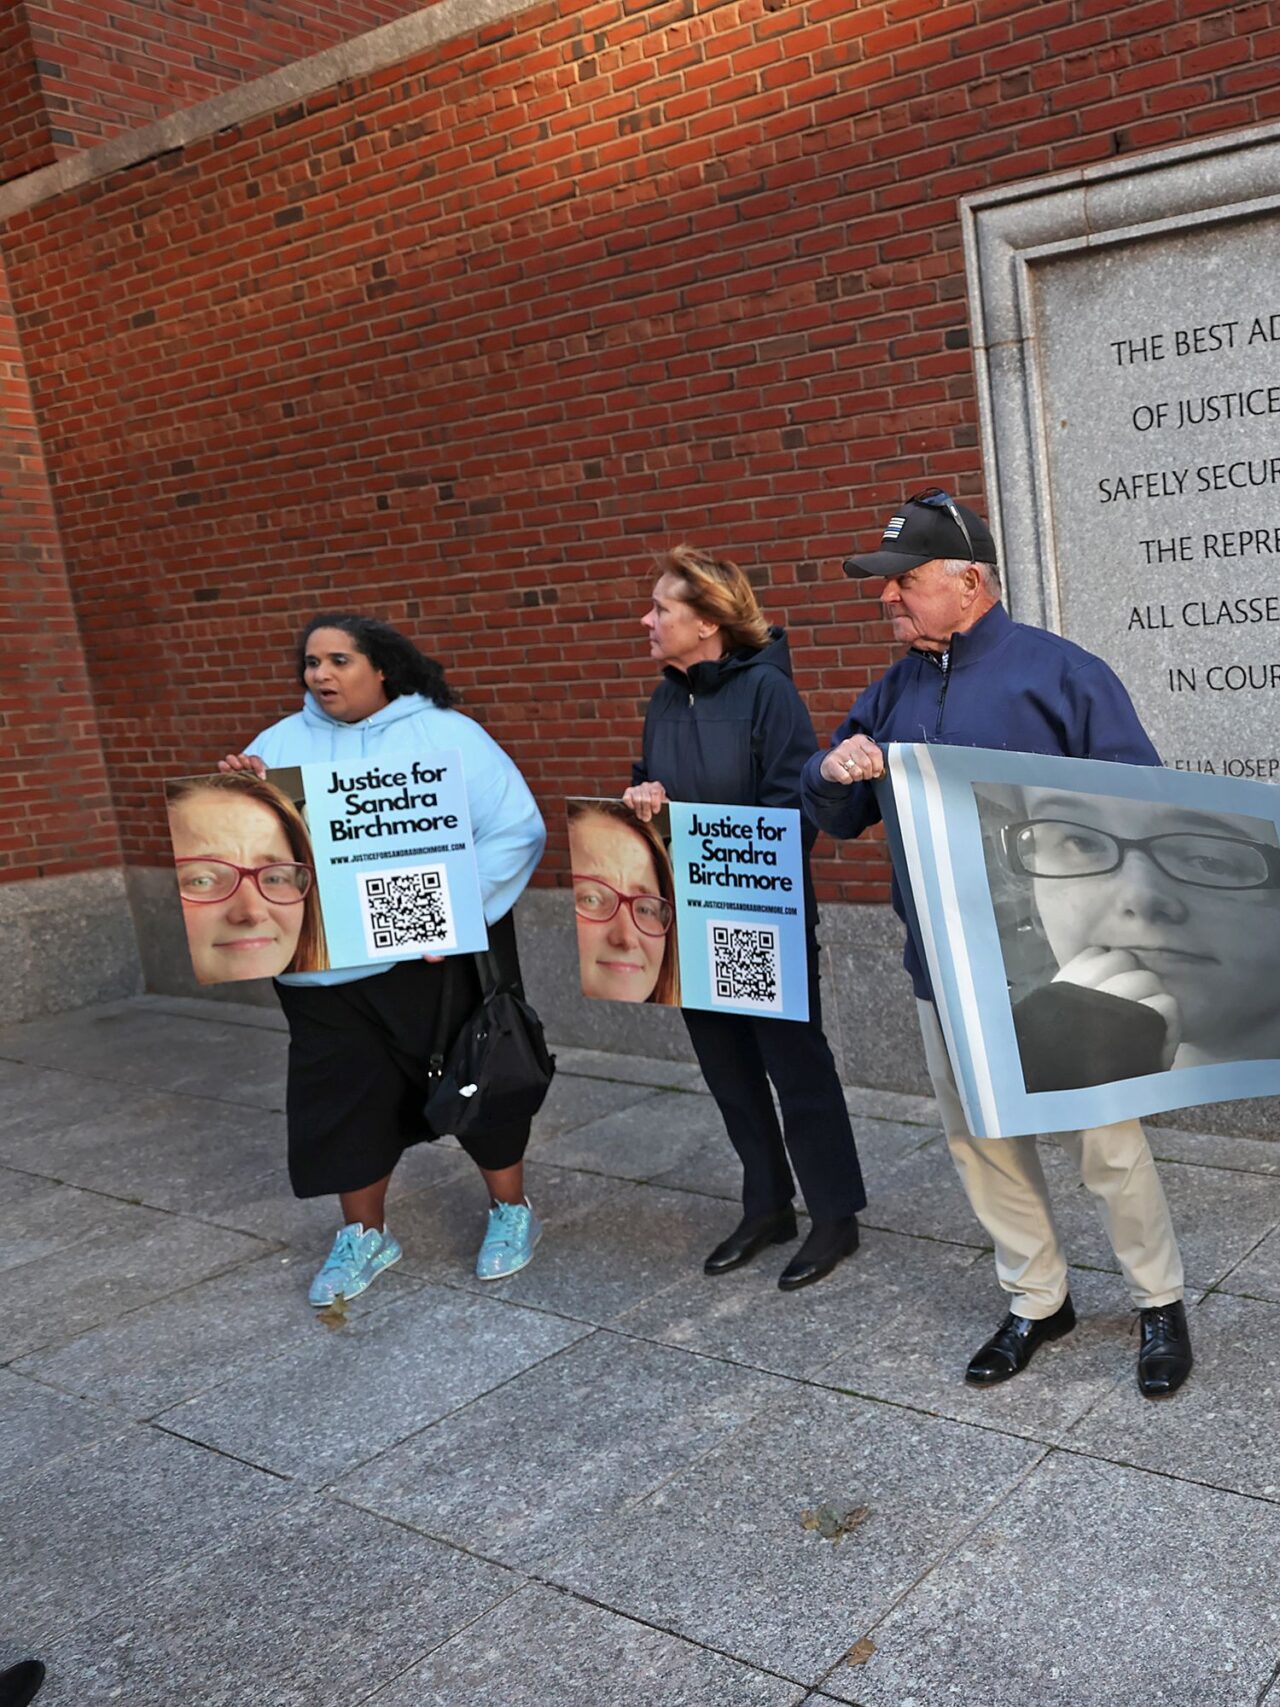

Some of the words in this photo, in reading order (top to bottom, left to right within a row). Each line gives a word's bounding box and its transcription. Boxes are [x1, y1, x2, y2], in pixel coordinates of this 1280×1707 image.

[1111, 335, 1165, 366] THE
[1176, 322, 1239, 356] BEST
[1133, 404, 1170, 432] OF
[1099, 467, 1189, 503] SAFELY
[1140, 537, 1193, 565] THE
[1128, 605, 1173, 631] ALL
[1169, 668, 1195, 692] IN
[327, 768, 407, 794] Justice
[411, 762, 447, 784] for
[345, 788, 438, 816] Sandra
[330, 812, 458, 842] Birchmore
[688, 814, 753, 839] Justice
[756, 817, 786, 841] for
[702, 840, 777, 866] Sandra
[689, 862, 793, 892] Birchmore
